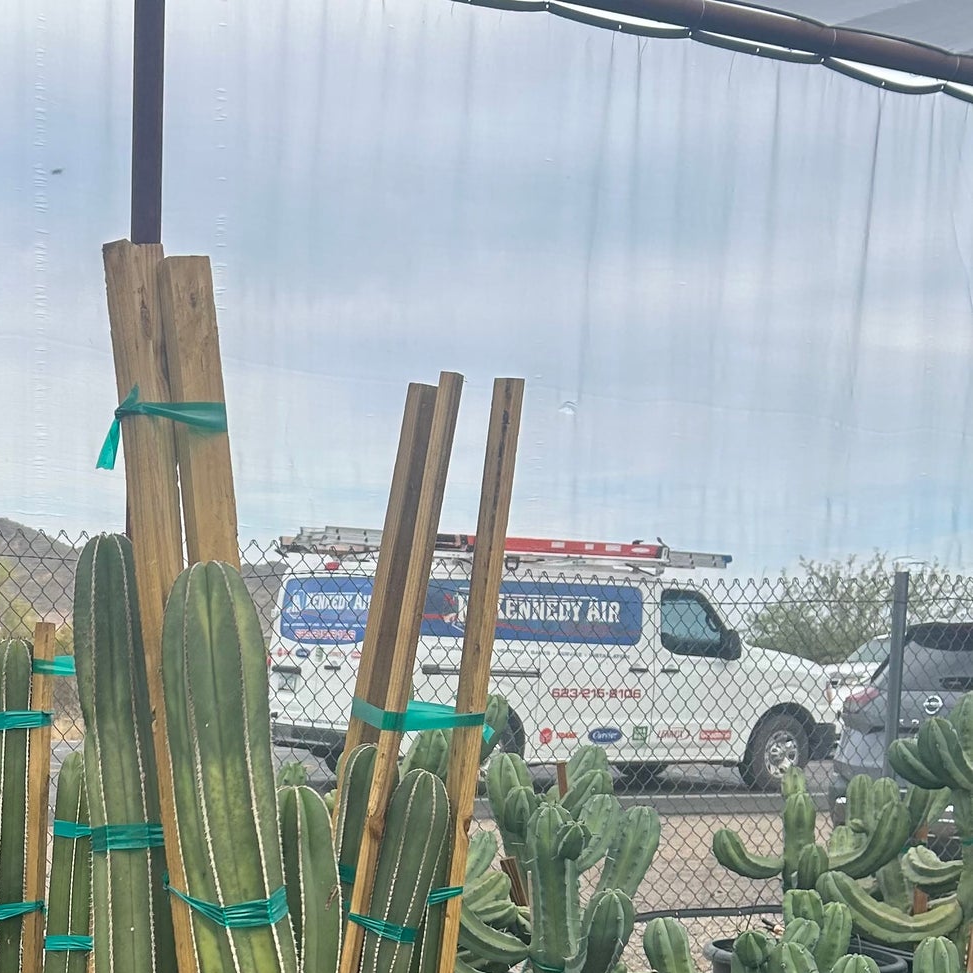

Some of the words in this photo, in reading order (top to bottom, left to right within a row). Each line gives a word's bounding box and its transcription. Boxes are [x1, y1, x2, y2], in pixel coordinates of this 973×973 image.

[305, 594, 354, 610] KENNEDY
[497, 598, 583, 622] KENNEDY
[586, 600, 621, 623] AIR
